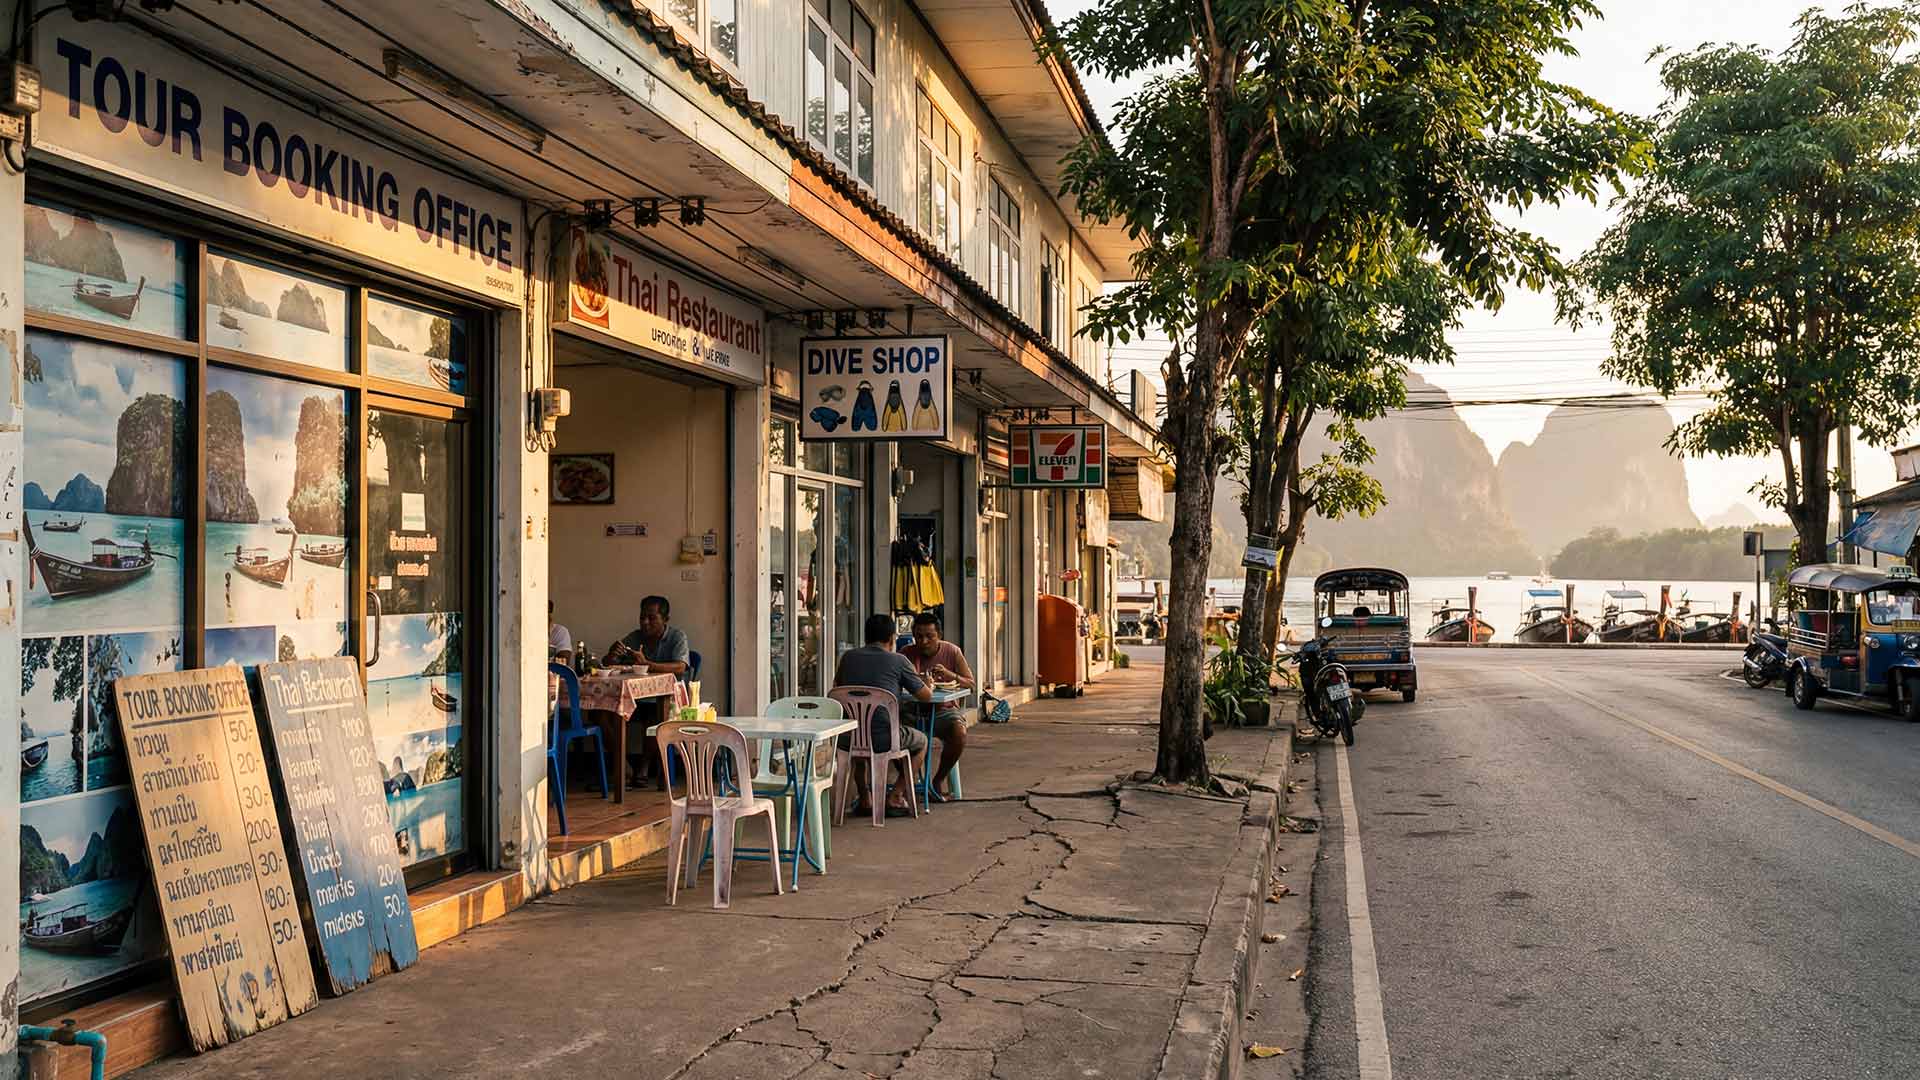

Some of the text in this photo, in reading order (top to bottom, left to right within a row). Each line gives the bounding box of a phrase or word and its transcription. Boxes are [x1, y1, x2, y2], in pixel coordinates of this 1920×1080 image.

[57, 37, 513, 273] TOUR BOOKING OFFICE
[613, 254, 761, 355] Thai Restaurant
[692, 336, 701, 357] &
[807, 346, 940, 375] DIVE SHOP
[123, 680, 249, 721] TOUR BOOKING OFFICE
[270, 674, 303, 707] Thai
